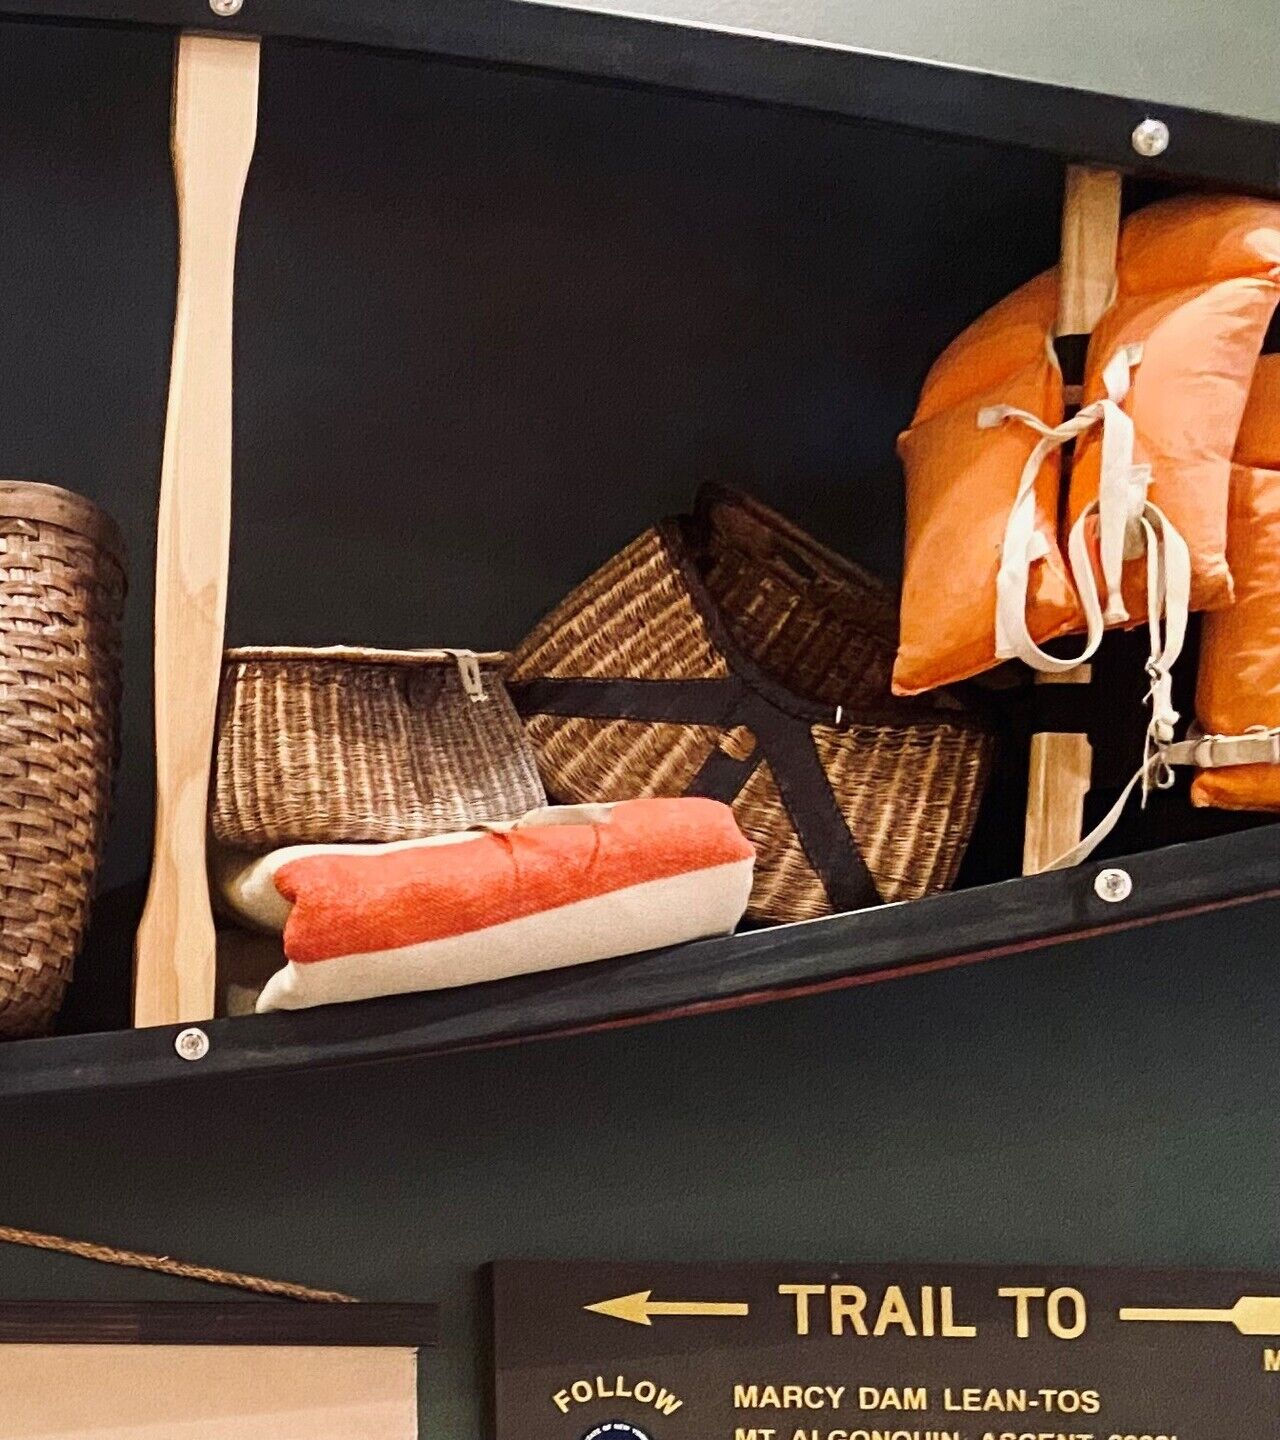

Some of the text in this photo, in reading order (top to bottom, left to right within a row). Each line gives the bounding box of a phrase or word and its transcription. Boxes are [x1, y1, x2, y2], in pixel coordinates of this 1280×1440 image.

[778, 1284, 1087, 1340] TRAIL TO
[552, 1375, 684, 1416] FOLLOW
[733, 1384, 1101, 1414] MARCY DAM LEAN-TOS
